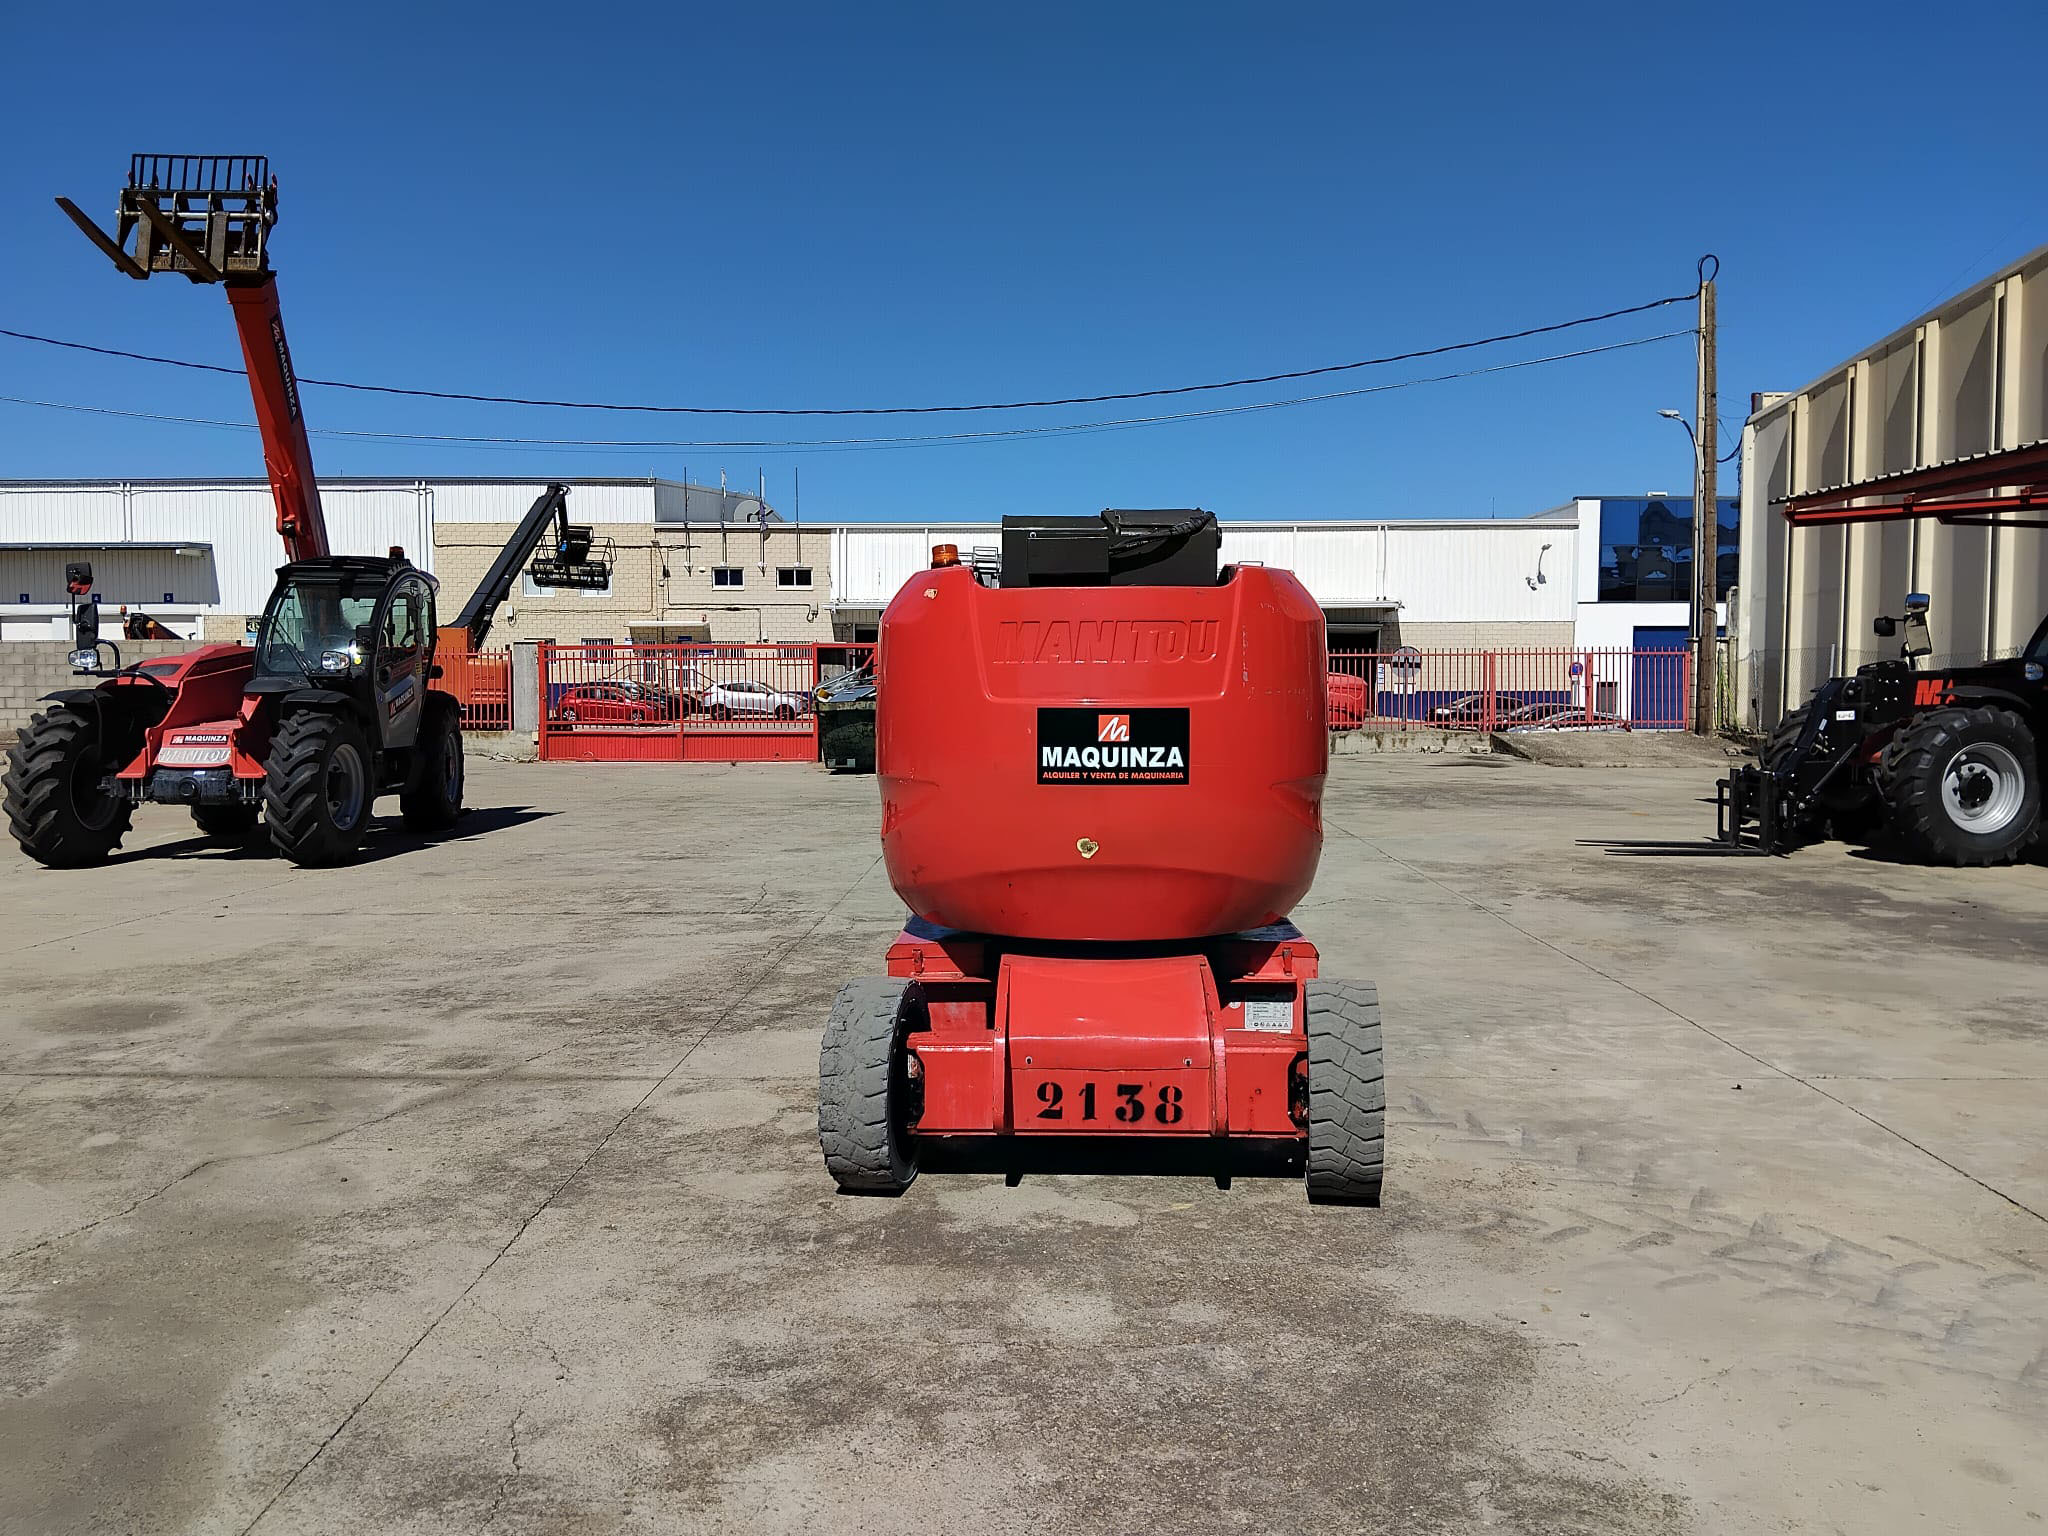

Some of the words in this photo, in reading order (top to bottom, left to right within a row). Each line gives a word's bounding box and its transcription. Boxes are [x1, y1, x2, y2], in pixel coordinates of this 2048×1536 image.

[278, 341, 297, 417] MAQUINZA
[992, 620, 1220, 664] MANITOU
[1042, 746, 1184, 769] MAQUINZA
[1042, 771, 1081, 779] ALQUILER
[1082, 771, 1088, 779] Y
[1131, 771, 1184, 779] MAQUINARIA
[1036, 1081, 1184, 1125] 2138
